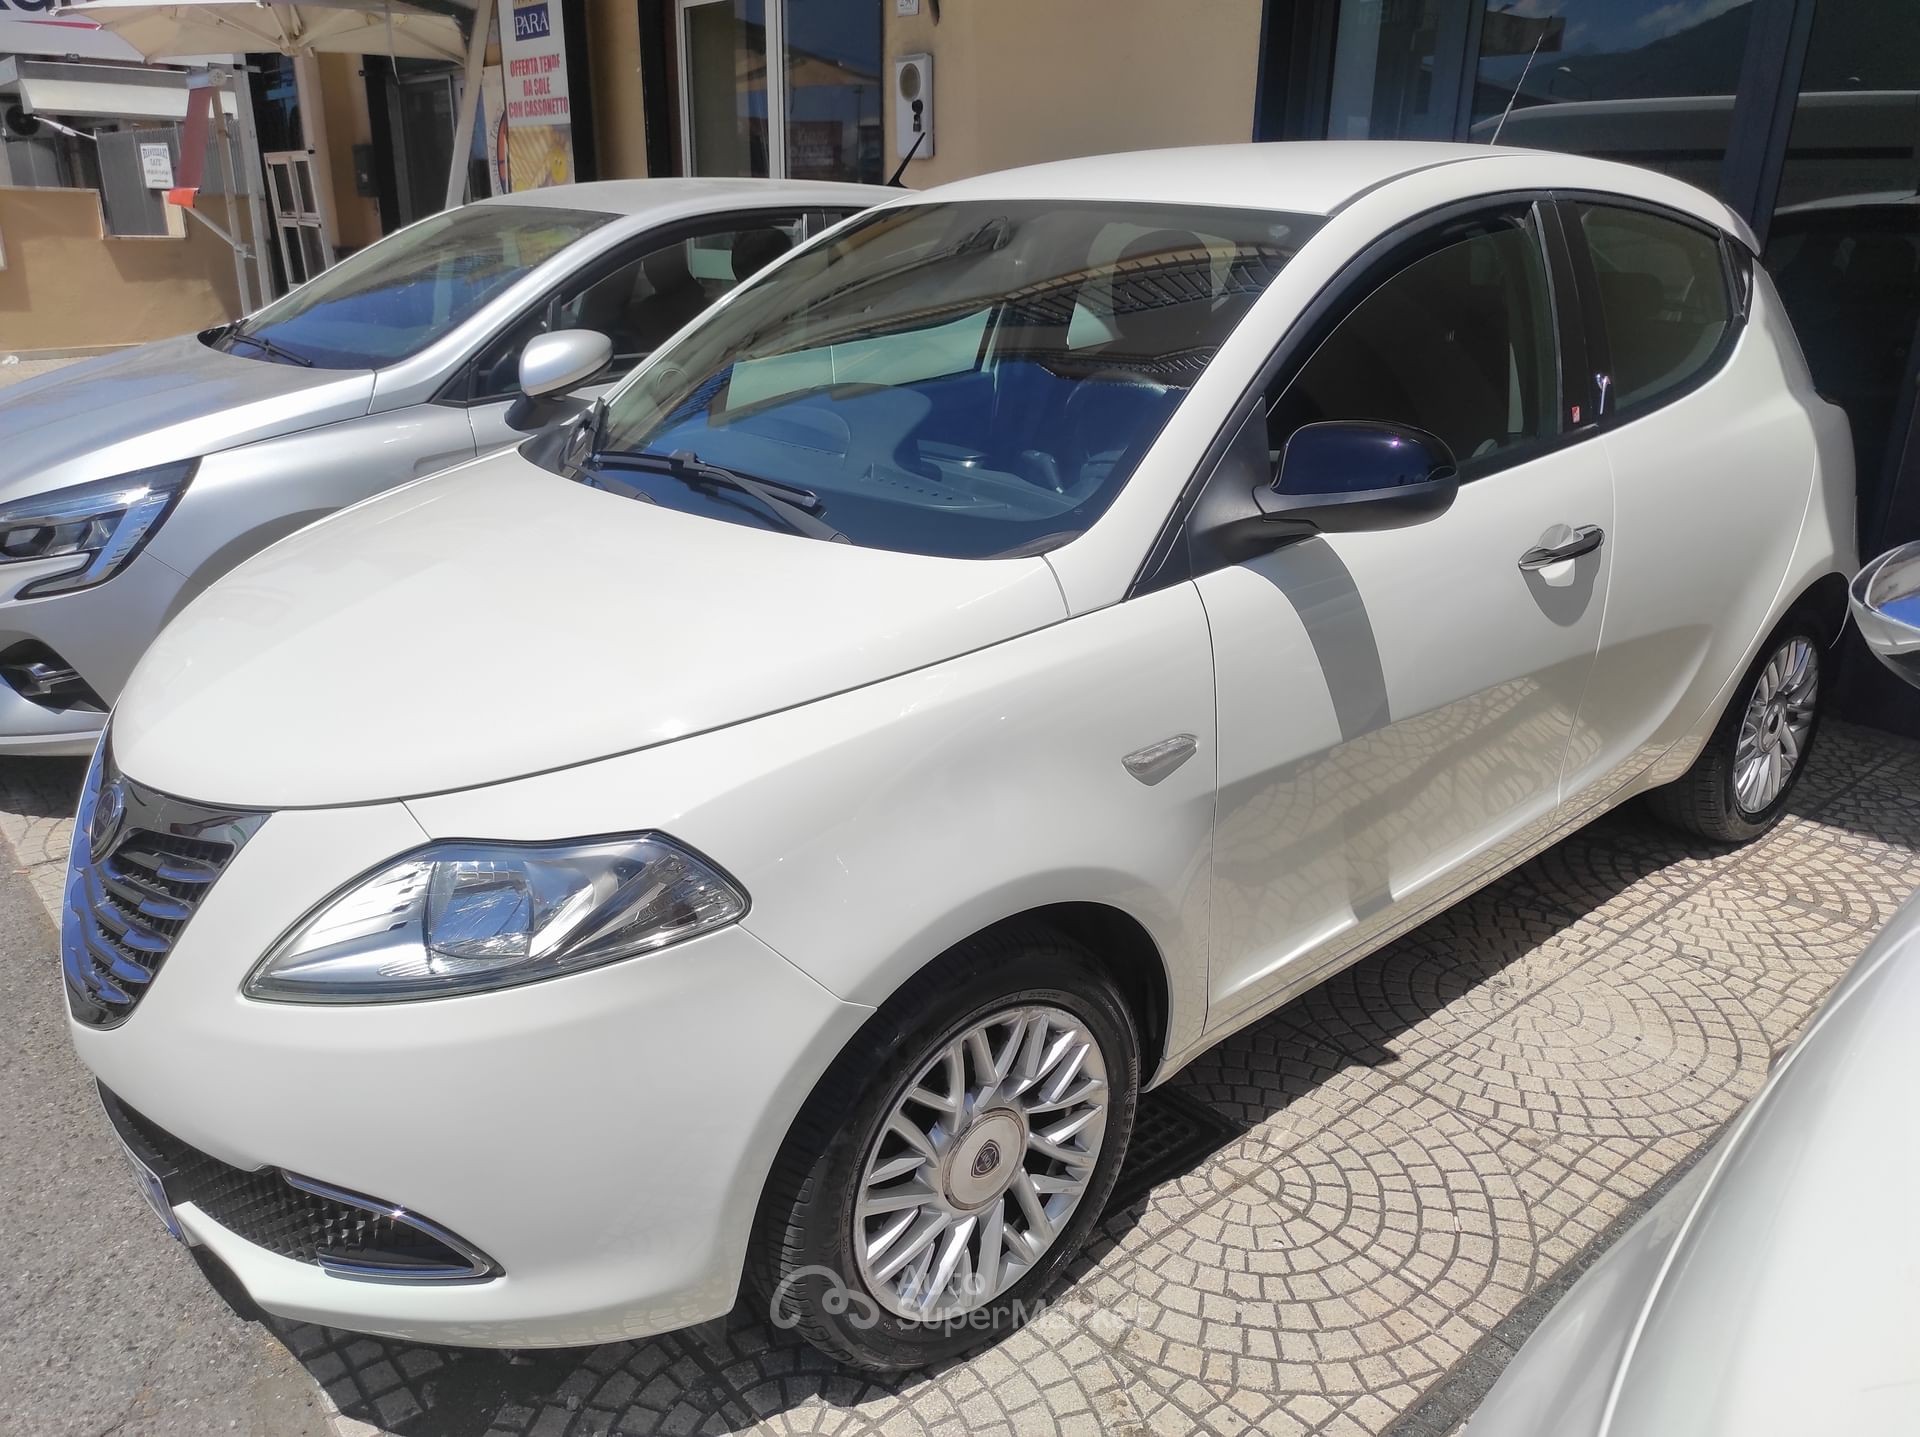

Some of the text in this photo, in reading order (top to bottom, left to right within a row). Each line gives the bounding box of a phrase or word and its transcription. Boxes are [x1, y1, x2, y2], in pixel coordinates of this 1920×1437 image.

[515, 10, 549, 35] PARA
[510, 57, 538, 77] OFFERTA
[523, 77, 550, 96] DA SOLE
[509, 96, 568, 118] CON CASSONETTO
